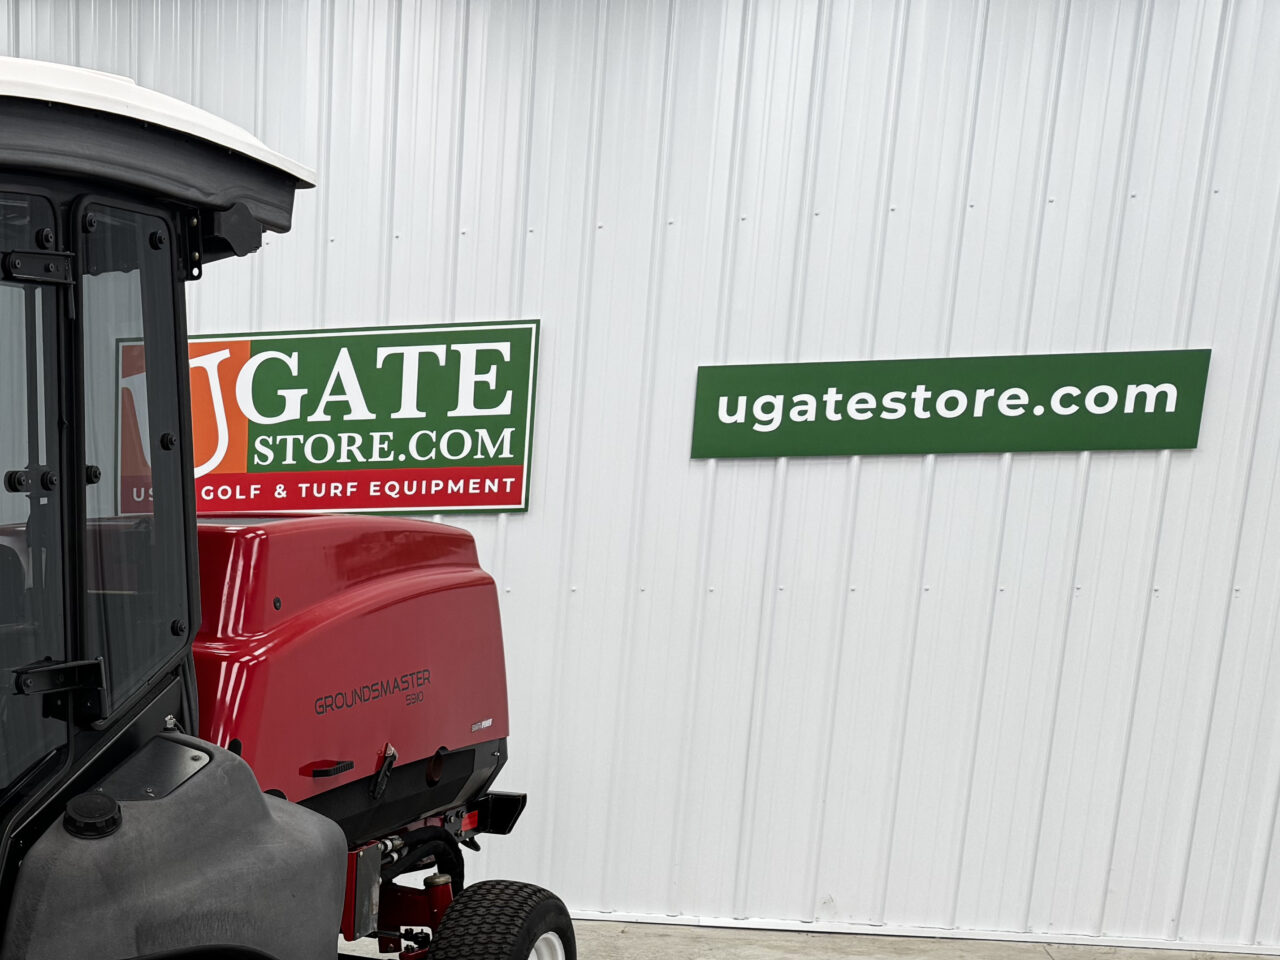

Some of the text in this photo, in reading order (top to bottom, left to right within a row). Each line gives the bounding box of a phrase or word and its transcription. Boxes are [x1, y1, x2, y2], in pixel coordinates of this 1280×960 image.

[718, 383, 1178, 433] ugatestore.com
[253, 427, 516, 466] STORE.COM
[201, 484, 261, 501] GOLF
[274, 484, 287, 499] &
[298, 481, 358, 498] TURF
[369, 477, 516, 498] EQUIPMENT
[314, 669, 431, 716] GROUNDSMASTER
